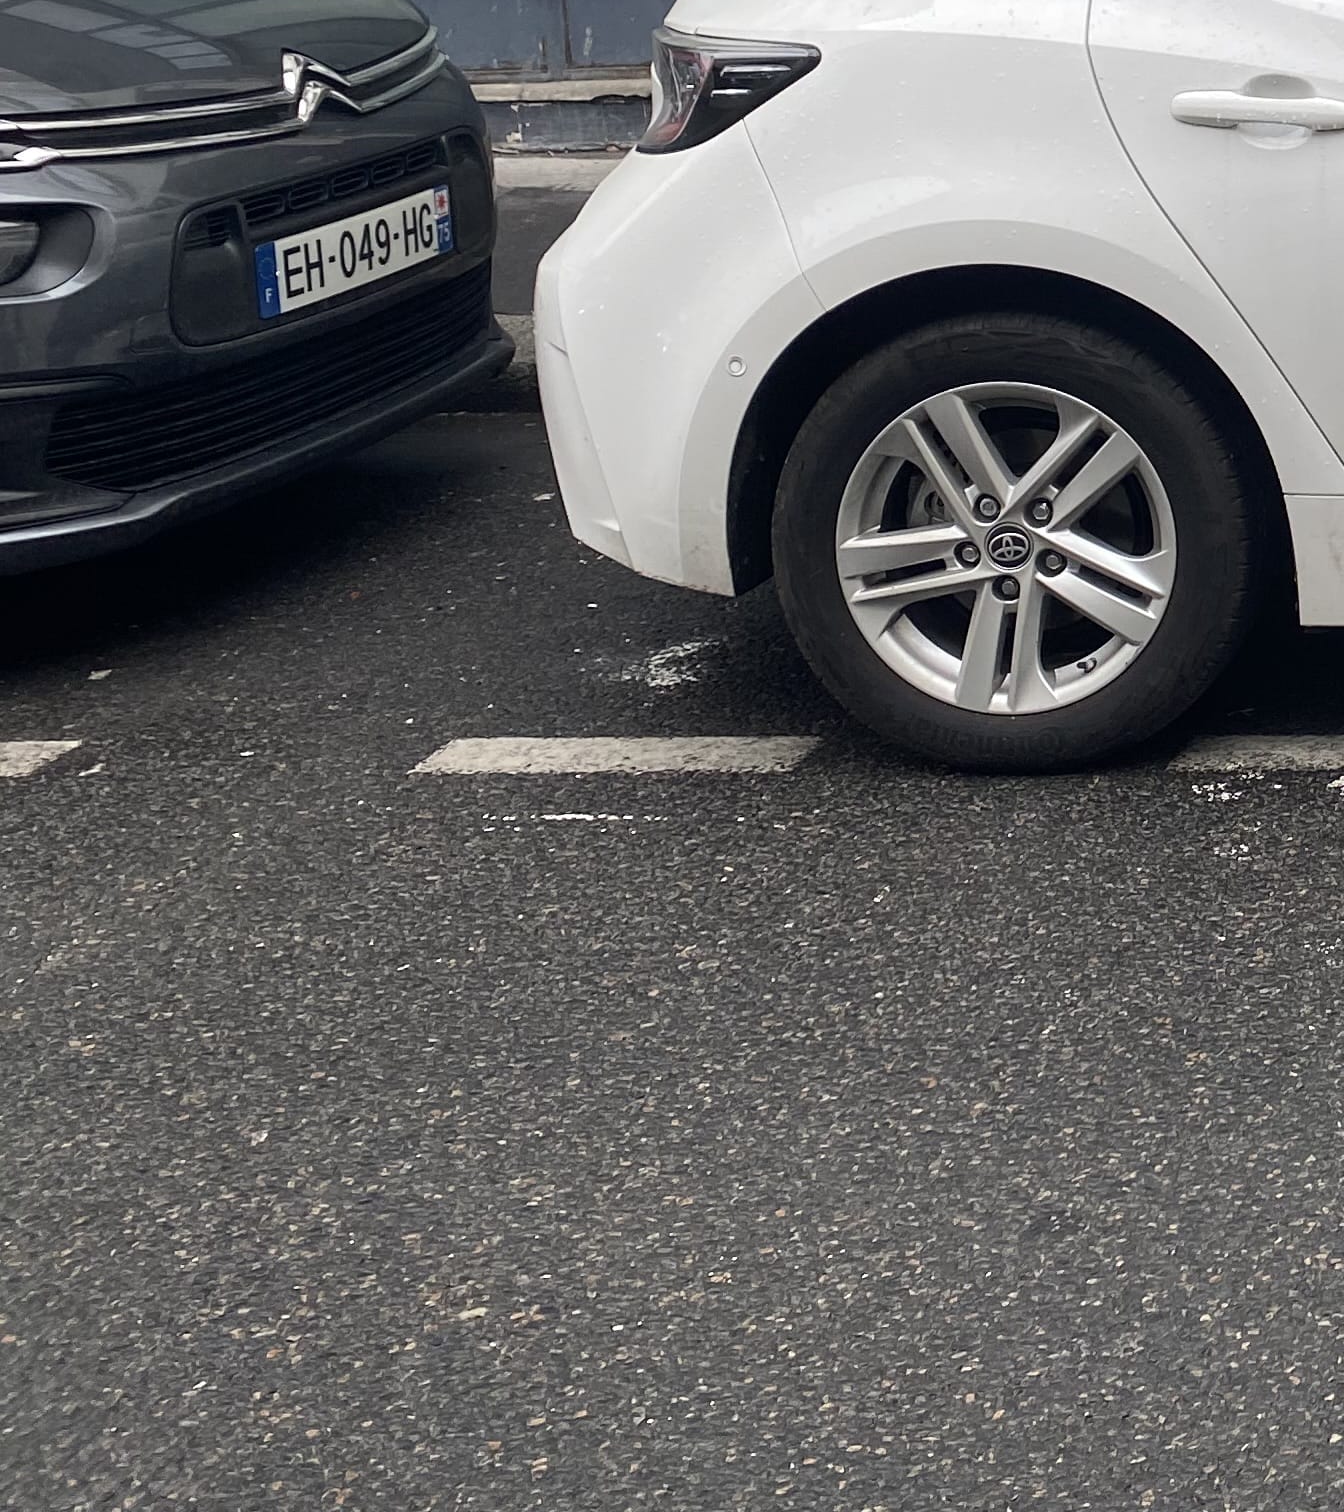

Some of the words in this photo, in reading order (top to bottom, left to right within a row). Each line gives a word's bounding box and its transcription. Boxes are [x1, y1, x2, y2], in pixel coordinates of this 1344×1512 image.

[438, 221, 450, 244] 75
[282, 202, 434, 299] EH-049-HG
[264, 287, 274, 304] F
